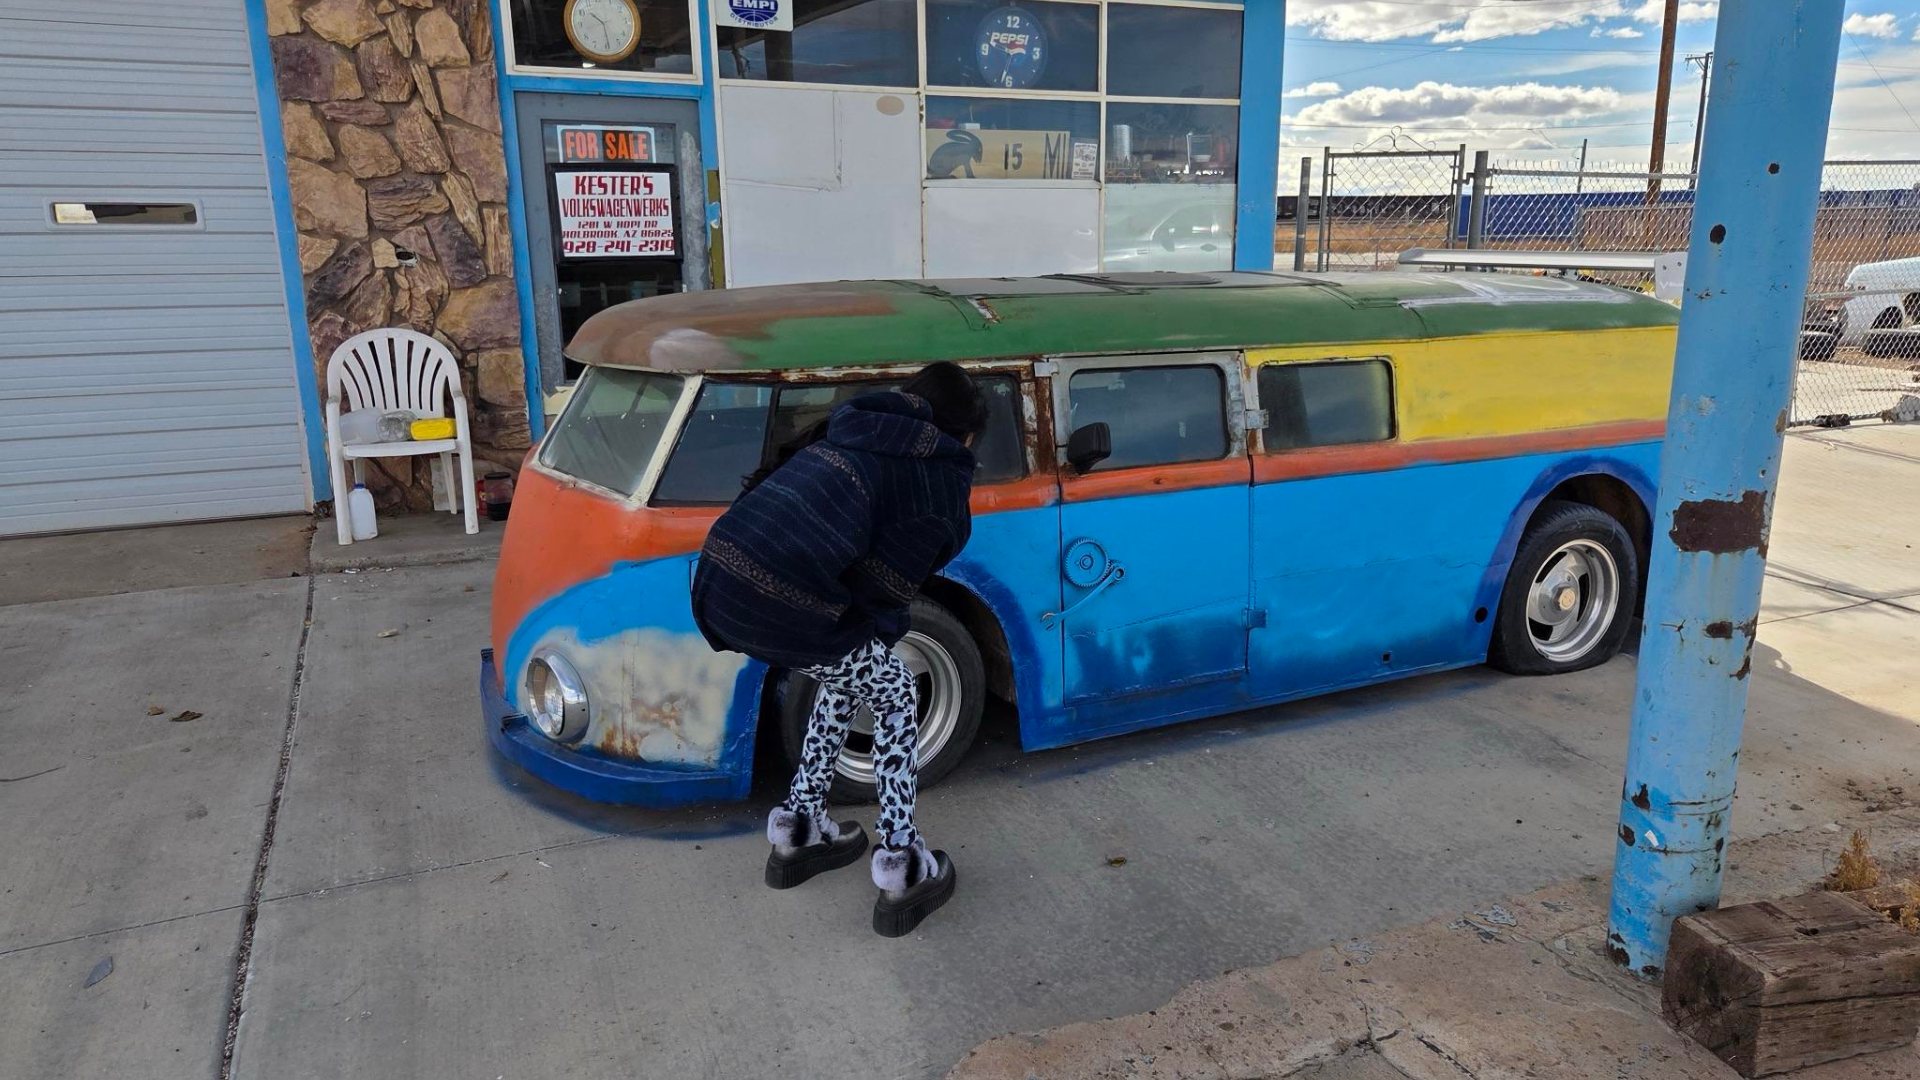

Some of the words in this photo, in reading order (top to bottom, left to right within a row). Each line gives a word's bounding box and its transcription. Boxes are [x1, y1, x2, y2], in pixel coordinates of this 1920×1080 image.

[732, 0, 777, 10] EMPI
[729, 12, 779, 28] DISTRIBUTOR
[1006, 15, 1020, 29] 12
[990, 32, 1029, 46] PEPSI
[981, 43, 989, 56] 9
[1032, 47, 1040, 60] 3
[1005, 75, 1013, 88] 6
[565, 131, 599, 159] FOR
[605, 132, 648, 160] SALE
[1004, 143, 1023, 171] 15
[1042, 132, 1067, 180] MI
[574, 174, 654, 196] KESTER'S
[562, 198, 669, 218] VOLKSWAGENWERKS
[603, 220, 613, 229] W
[616, 220, 641, 229] HOPI
[644, 220, 658, 229] DR
[623, 229, 638, 239] AZ
[564, 240, 674, 254] 928-241-2319
